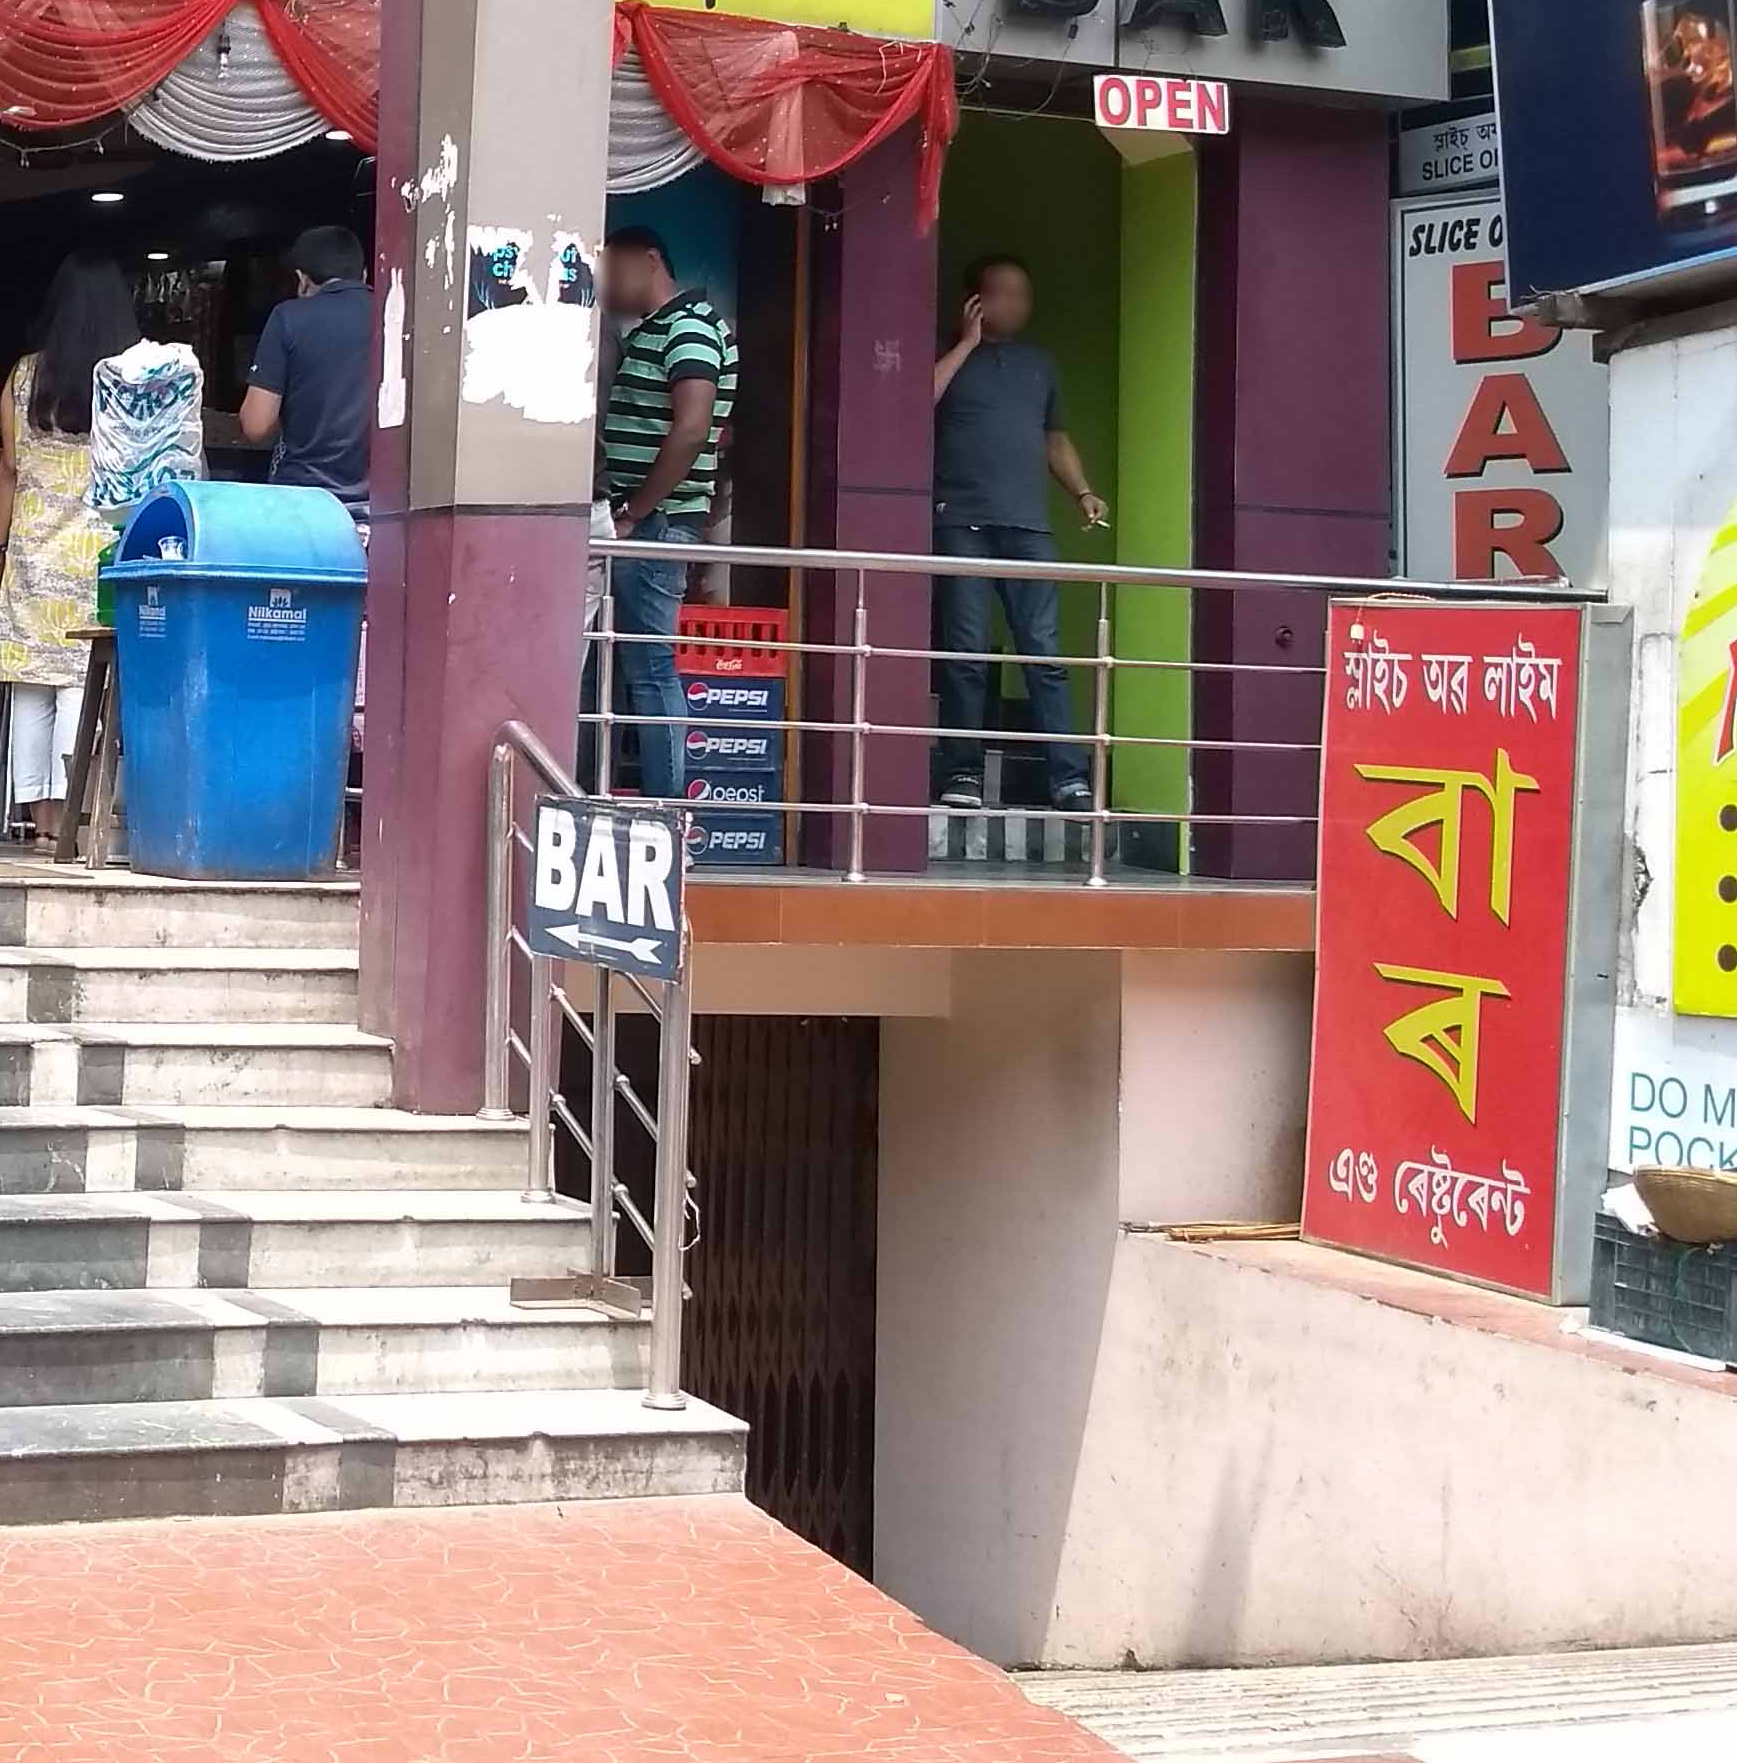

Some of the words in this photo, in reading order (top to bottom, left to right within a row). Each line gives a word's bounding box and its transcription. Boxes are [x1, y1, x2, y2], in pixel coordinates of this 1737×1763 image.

[1098, 77, 1227, 133] OPEN
[1422, 153, 1474, 181] SLICE
[1479, 147, 1499, 170] O
[1408, 217, 1481, 258] SLICE
[1488, 214, 1504, 248] O
[1443, 260, 1573, 580] BAR
[248, 605, 307, 621] Nilkamal
[706, 688, 769, 707] PEPSI
[1483, 632, 1562, 724] লাইম
[705, 738, 768, 755] PEPSI
[709, 831, 767, 850] PEPSI
[535, 806, 676, 932] BAR
[1630, 1072, 1688, 1119] DO
[1329, 1147, 1379, 1203] এণ্ড
